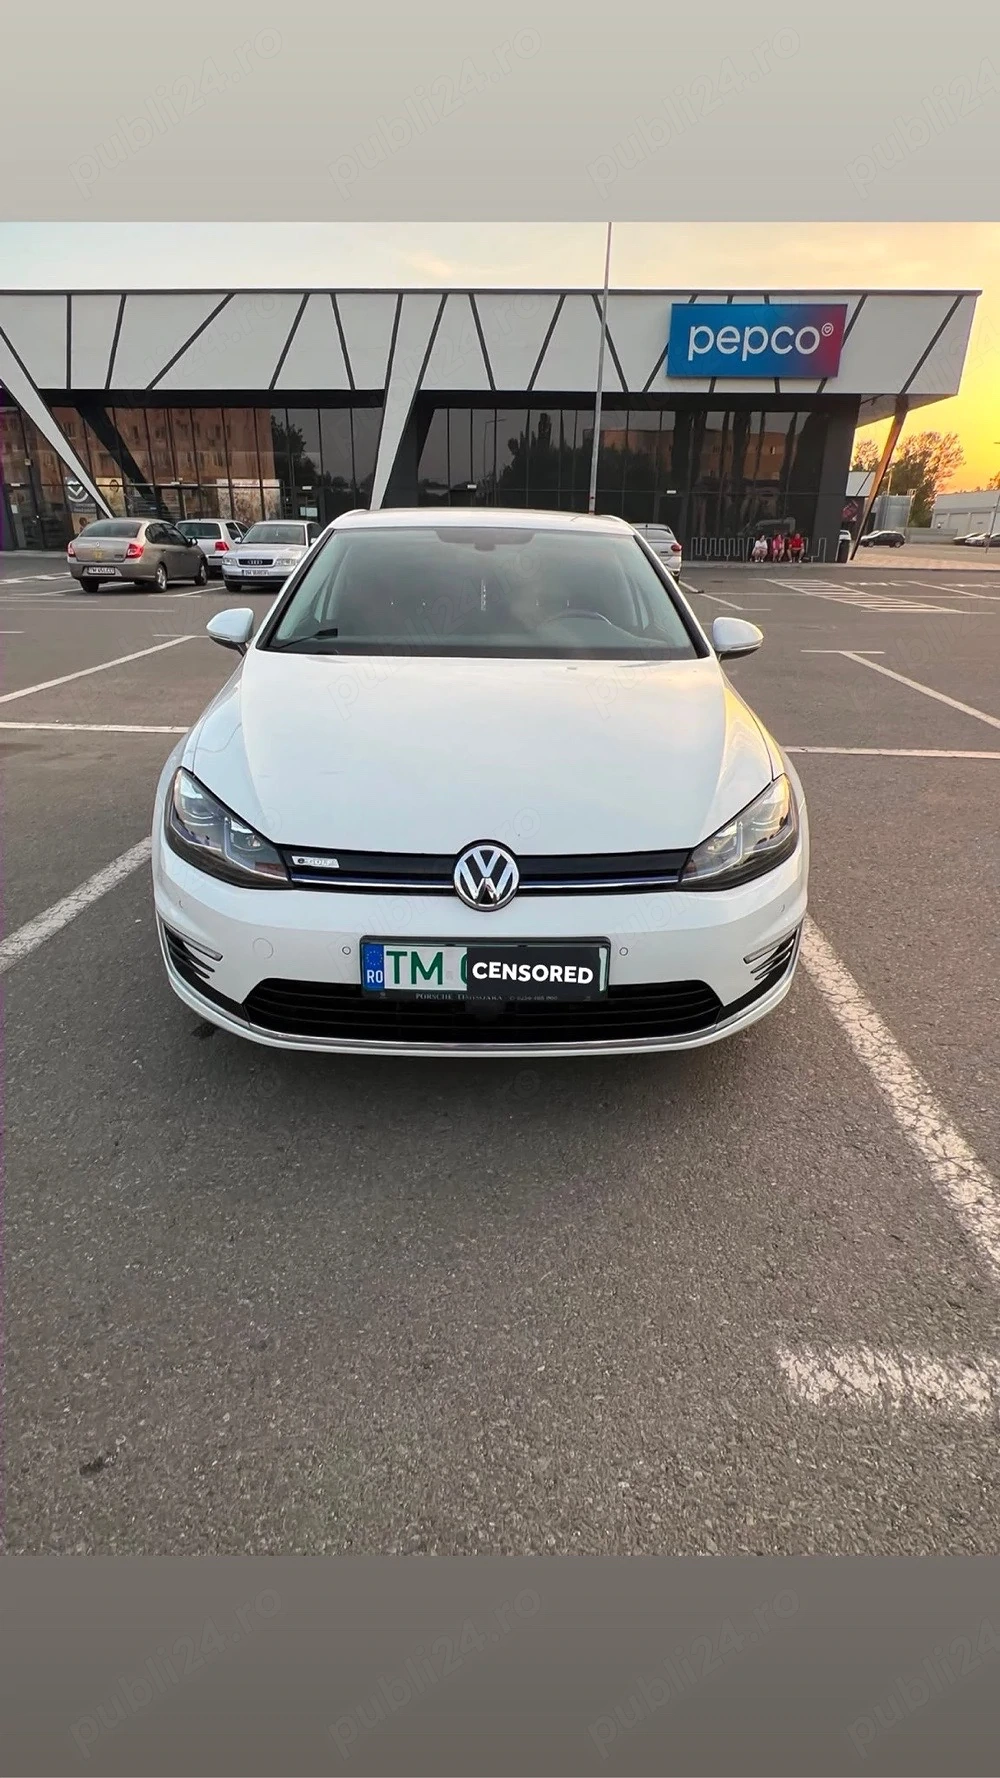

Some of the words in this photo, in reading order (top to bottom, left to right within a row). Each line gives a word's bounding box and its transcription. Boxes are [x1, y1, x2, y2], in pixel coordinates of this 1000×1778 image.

[688, 326, 821, 362] pepco
[367, 970, 383, 984] RO
[386, 951, 443, 986] TM
